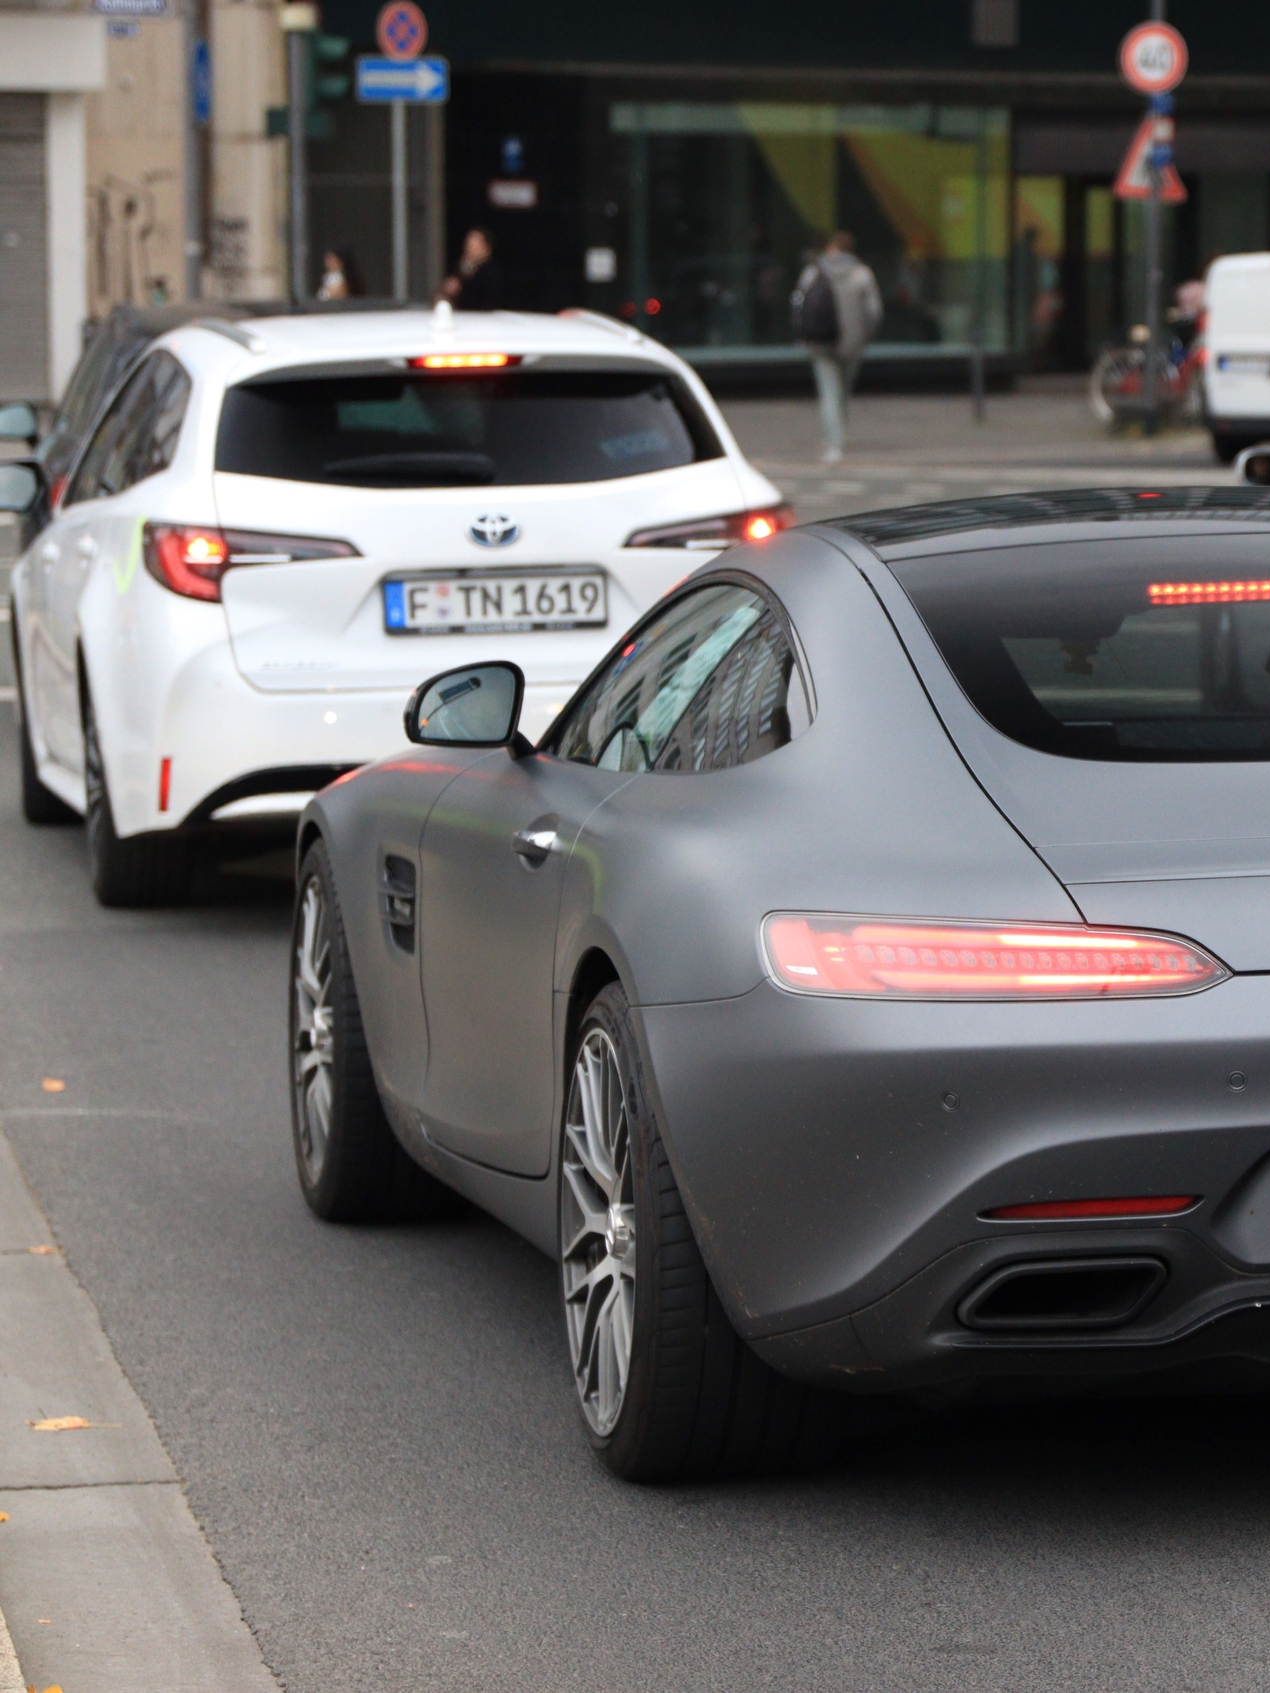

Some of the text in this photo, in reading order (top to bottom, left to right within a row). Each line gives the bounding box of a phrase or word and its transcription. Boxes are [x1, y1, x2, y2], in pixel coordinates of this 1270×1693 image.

[1137, 43, 1171, 70] 40
[408, 581, 600, 619] F TN 1619
